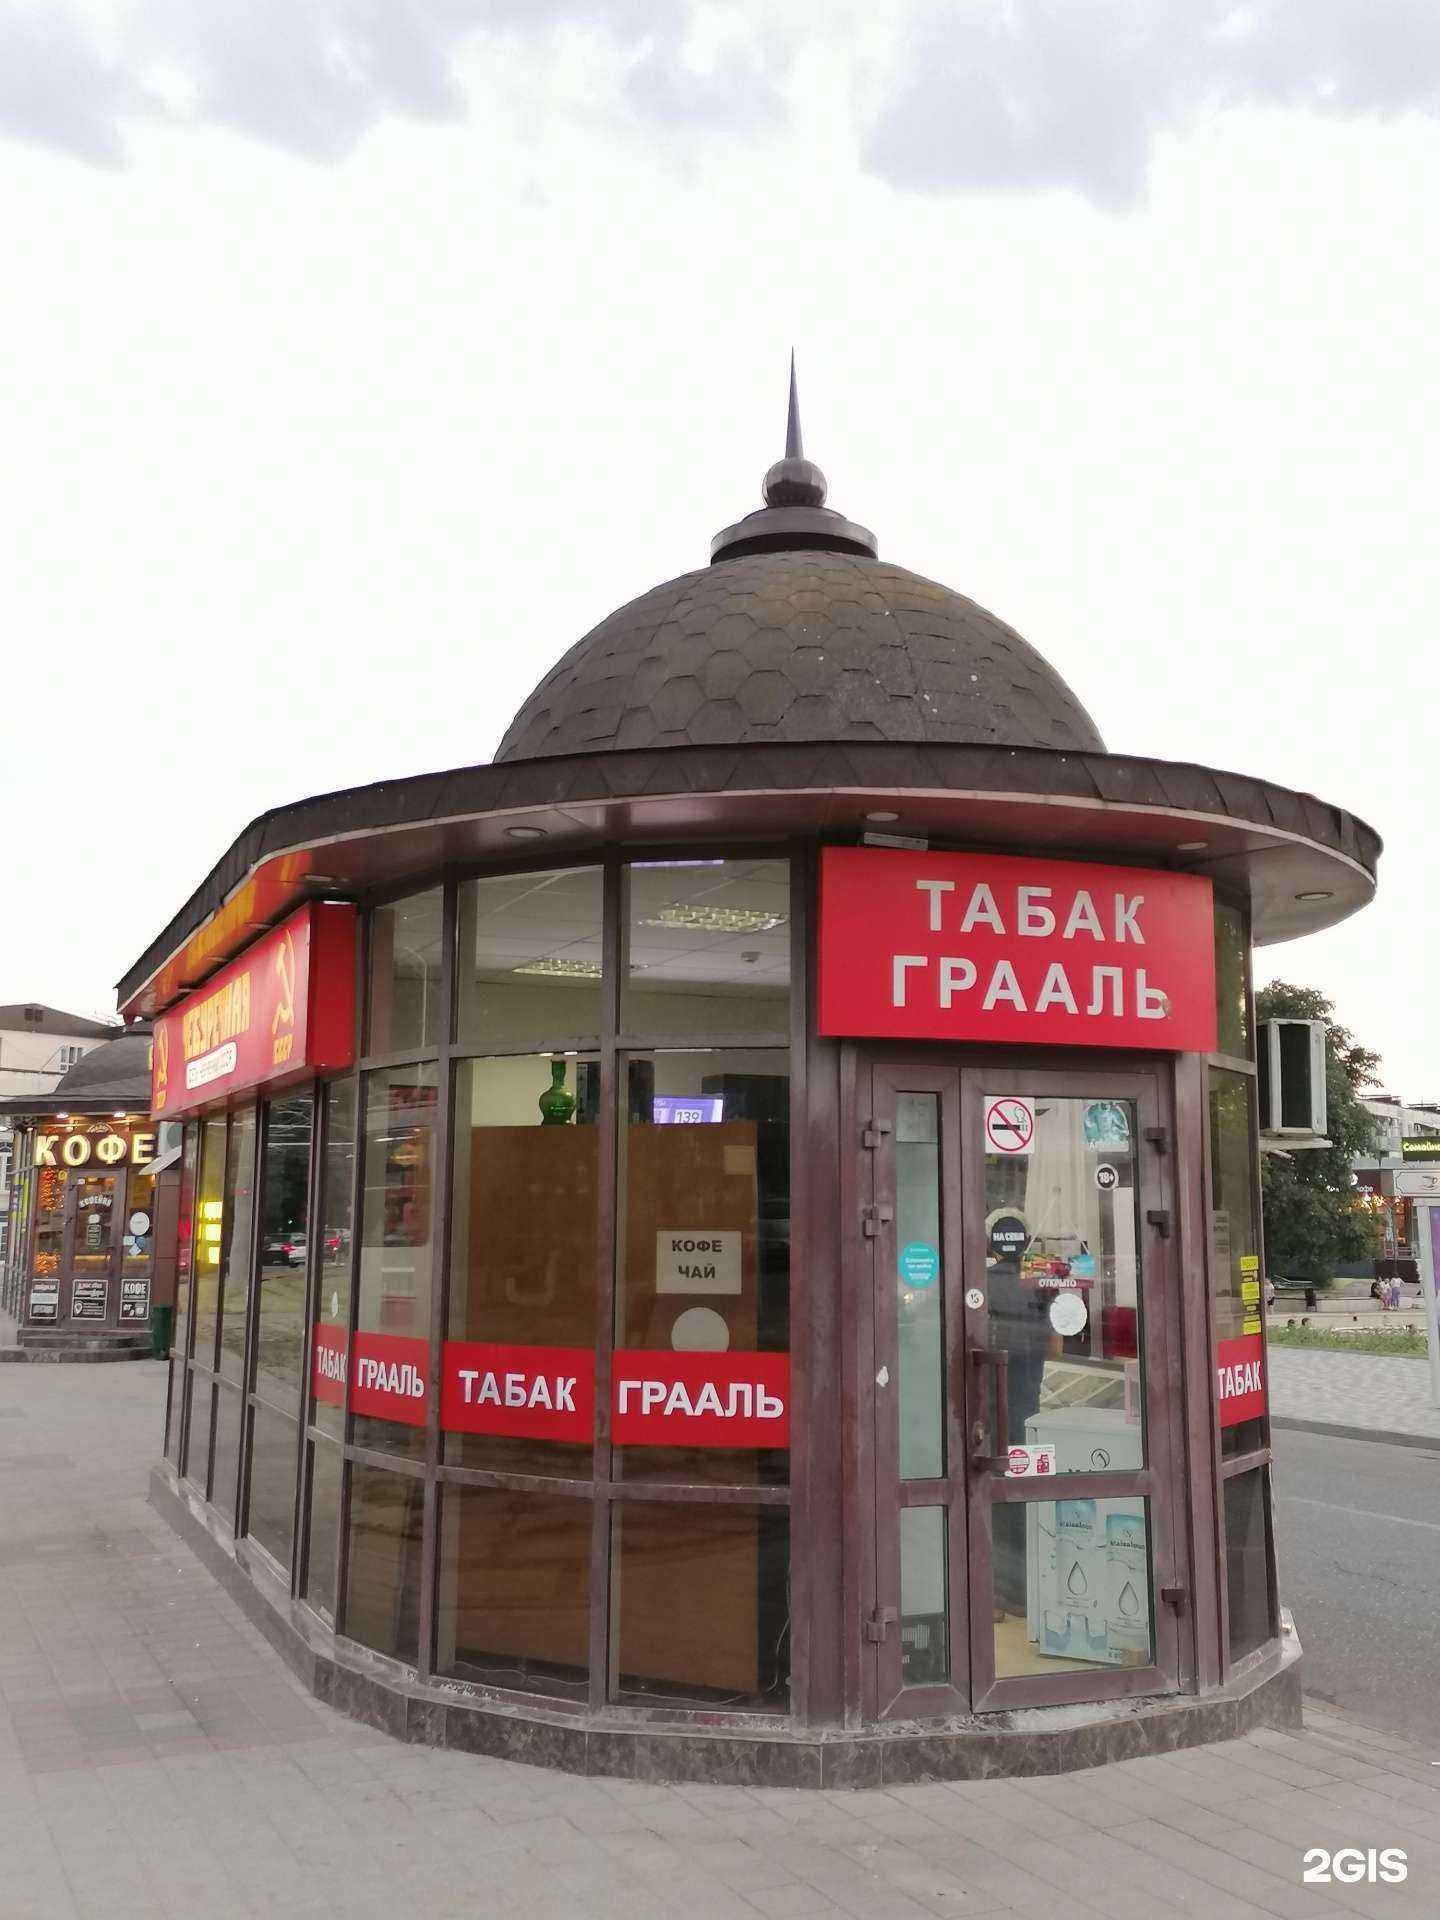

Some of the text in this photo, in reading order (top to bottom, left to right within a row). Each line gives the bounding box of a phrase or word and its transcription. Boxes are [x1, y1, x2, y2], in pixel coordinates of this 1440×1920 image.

[915, 879, 1146, 945] ТАБАК
[892, 954, 1170, 1020] ГРААЛЬ
[677, 1111, 700, 1124] 139
[34, 1133, 155, 1167] КОФЕ
[1098, 1171, 1114, 1183] 18+
[671, 1239, 723, 1254] КОФЕ
[678, 1262, 716, 1279] ЧАЙ
[1038, 1278, 1077, 1288] ОТКРЫТО
[317, 1345, 347, 1384] ТАБАК
[358, 1358, 425, 1398] ГРААЛЬ
[1217, 1360, 1262, 1399] ТАБАК
[457, 1369, 577, 1412] ТАБАК
[617, 1379, 785, 1419] ГРААЛЬ
